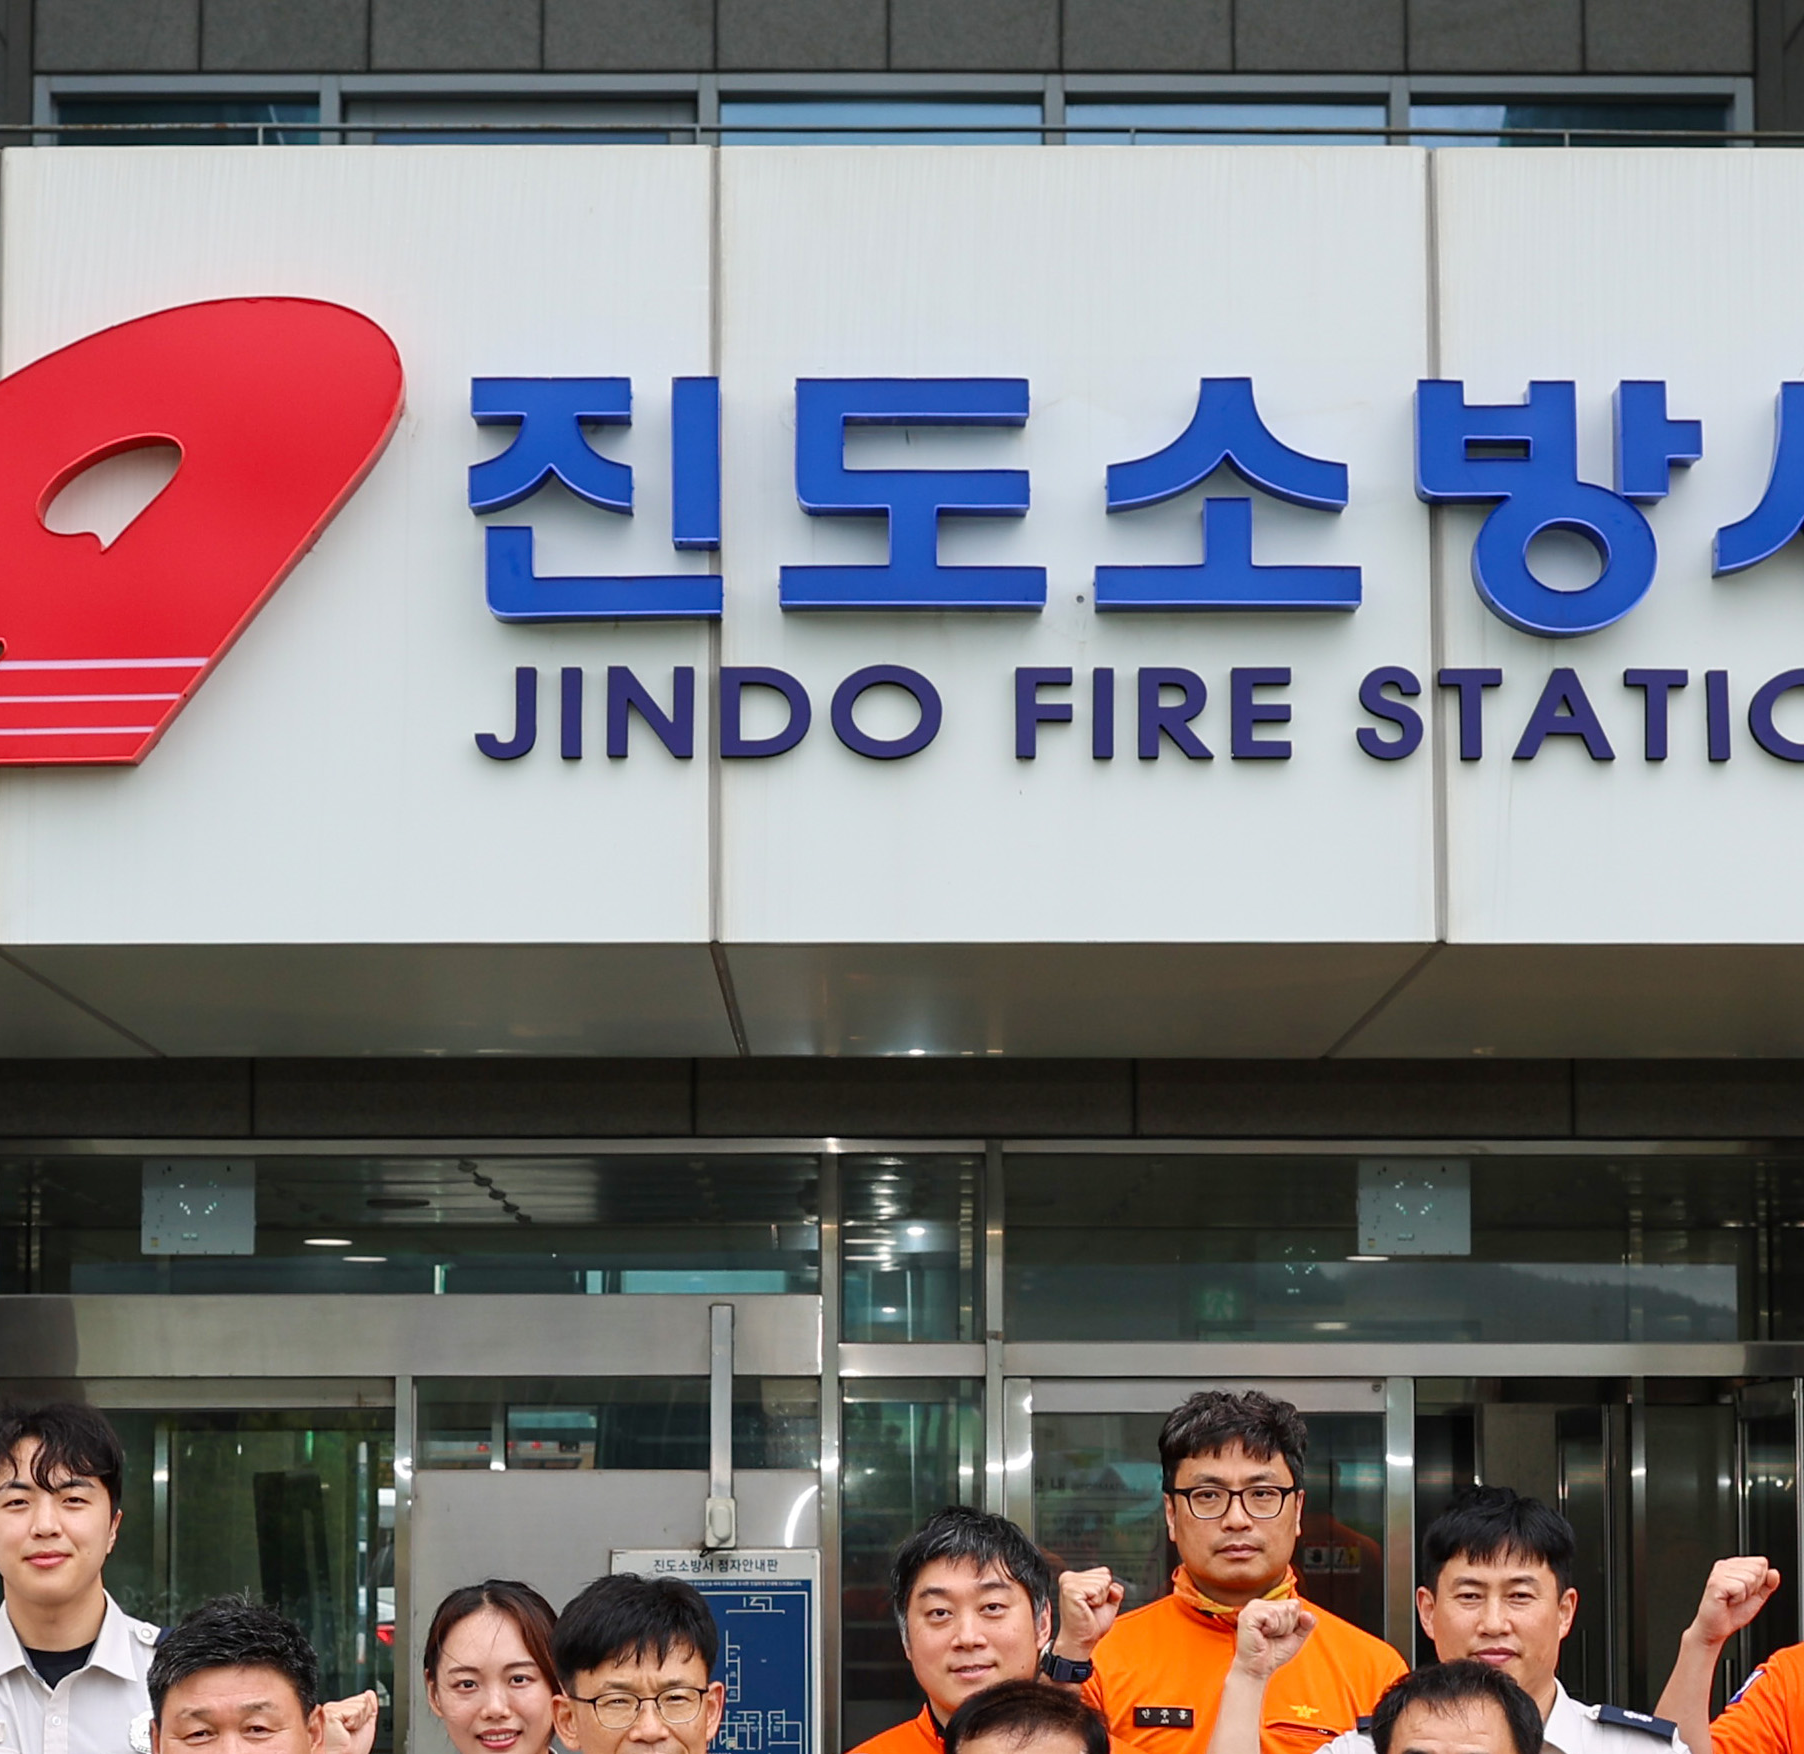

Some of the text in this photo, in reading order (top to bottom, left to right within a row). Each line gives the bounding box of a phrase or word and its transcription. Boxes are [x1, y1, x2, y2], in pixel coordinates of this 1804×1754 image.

[474, 664, 943, 761] JINDO
[1013, 666, 1293, 761] FIRE
[653, 1558, 779, 1574] 진도소방서 점자안내판
